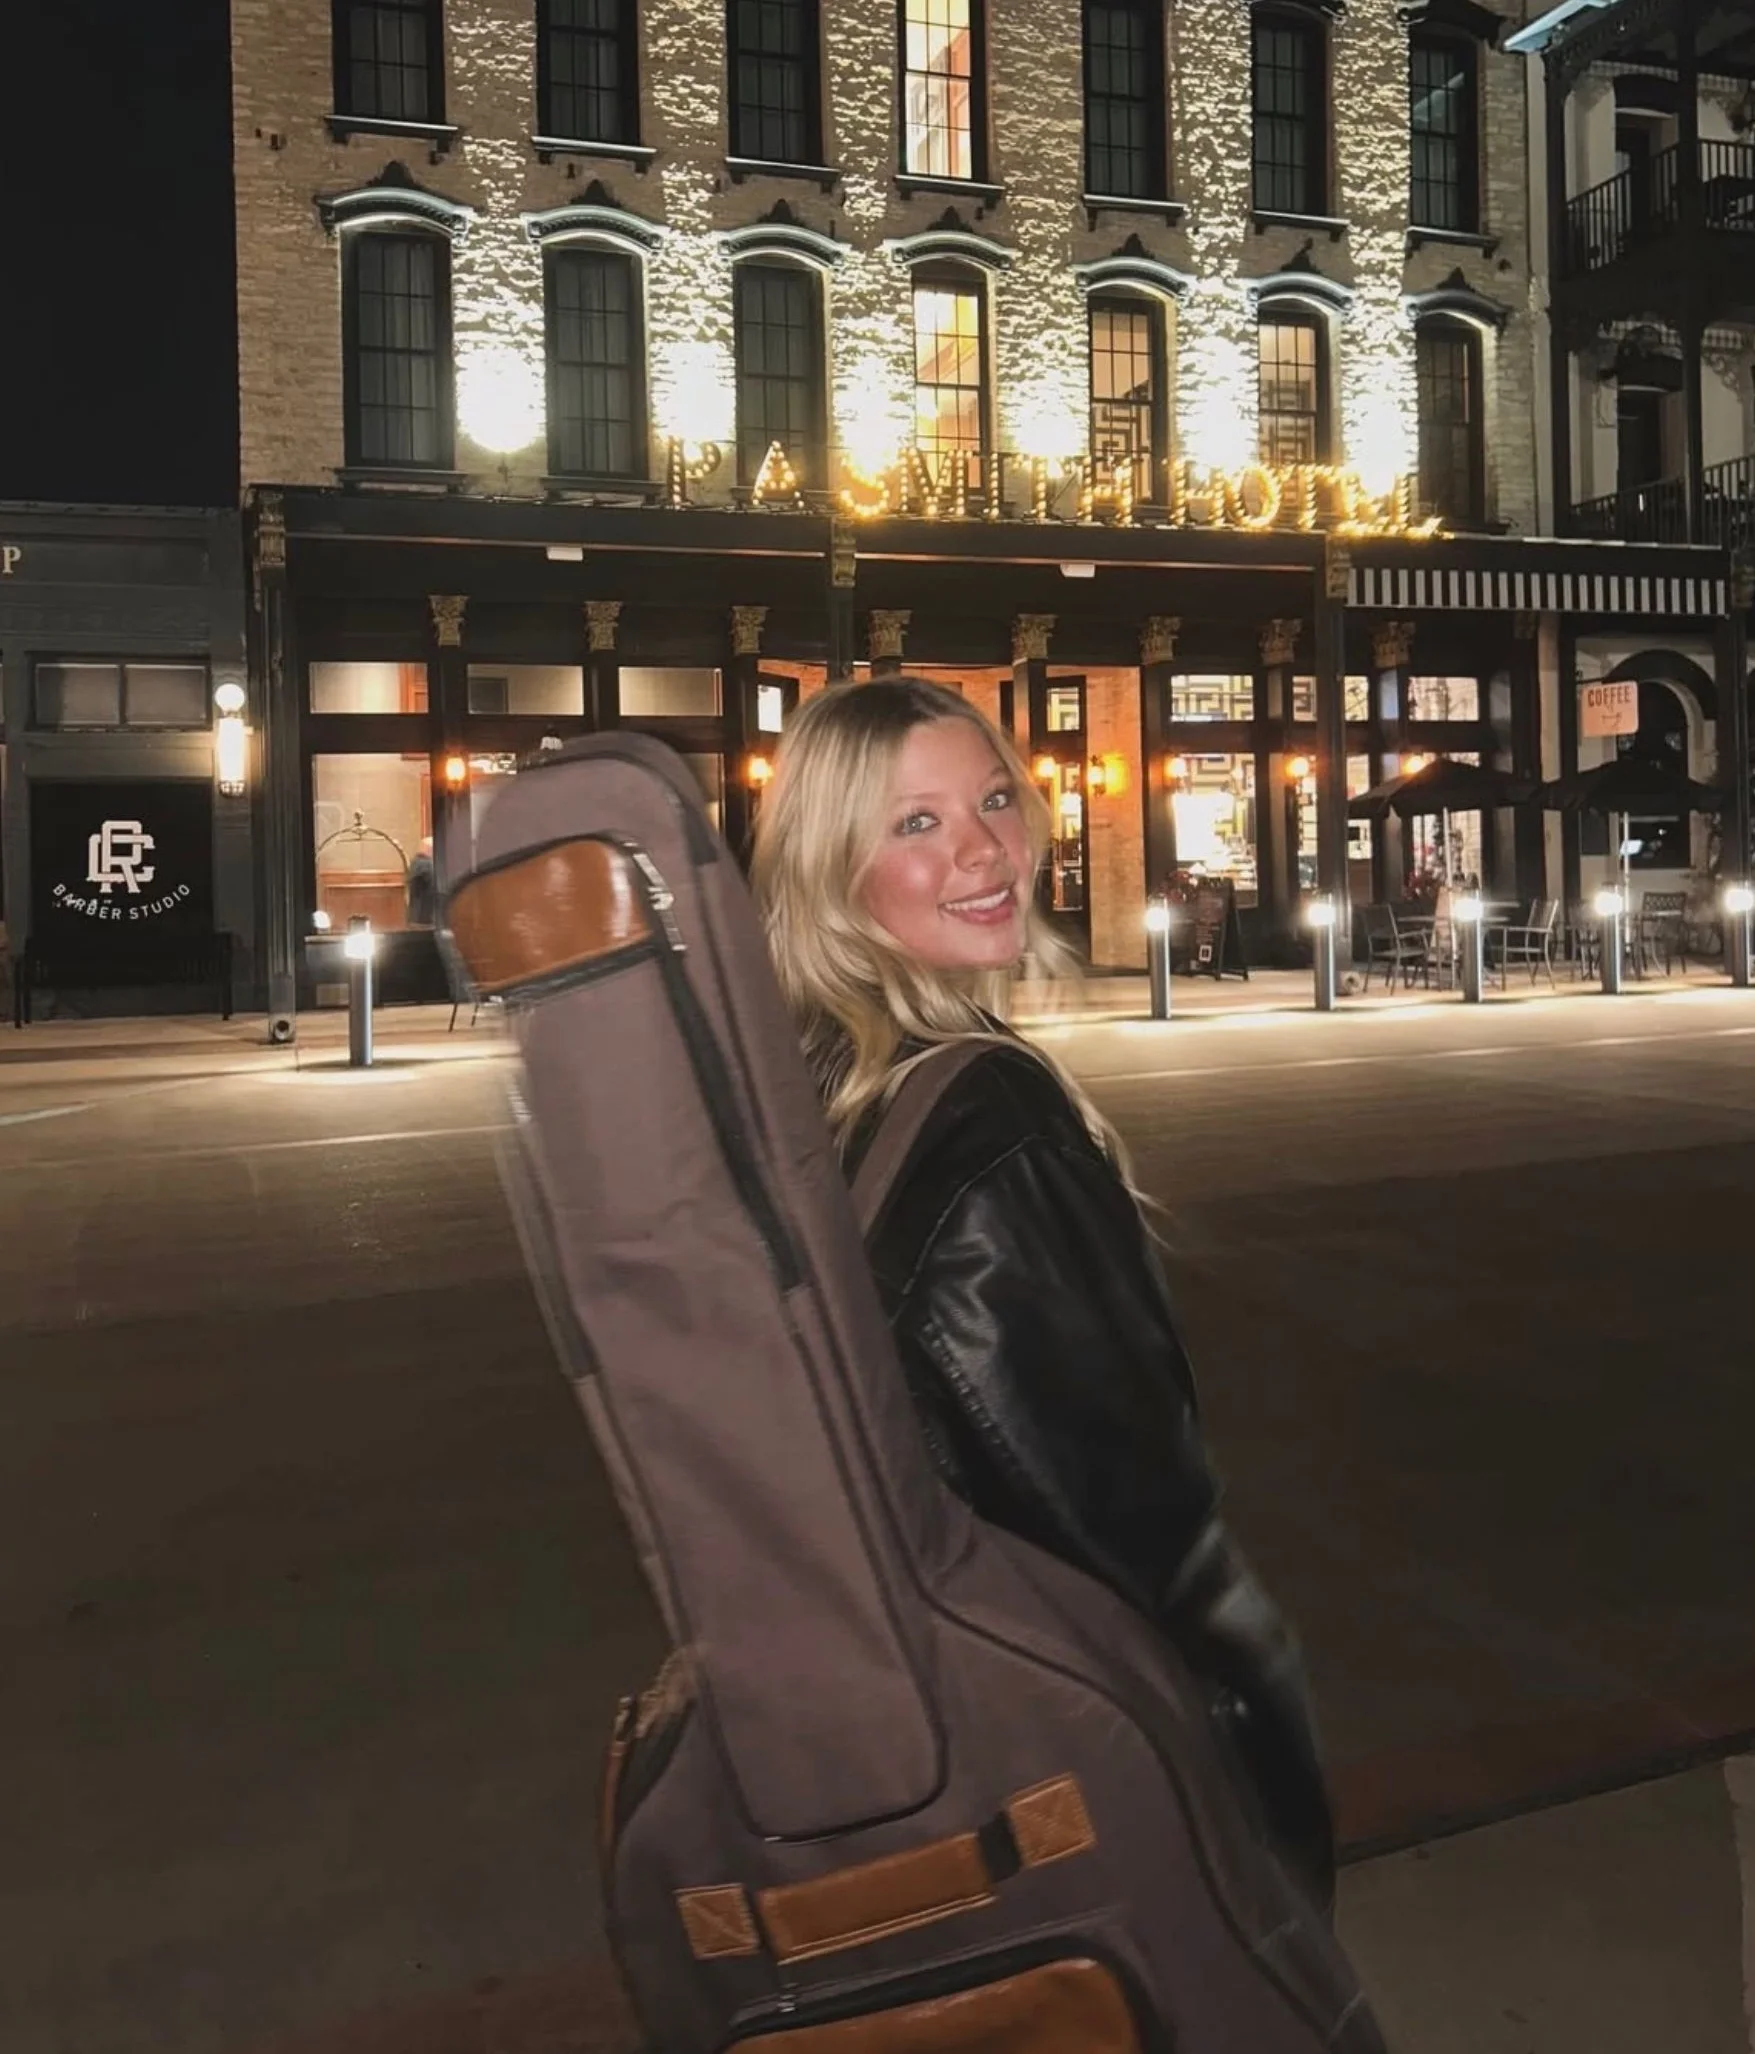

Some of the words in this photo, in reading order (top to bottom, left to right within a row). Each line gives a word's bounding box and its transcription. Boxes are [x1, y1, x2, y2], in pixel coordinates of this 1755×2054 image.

[751, 440, 805, 506] A
[2, 545, 22, 574] P
[1587, 686, 1632, 708] COFFEE
[53, 883, 122, 920] BARBER
[129, 884, 190, 920] STUDIO
